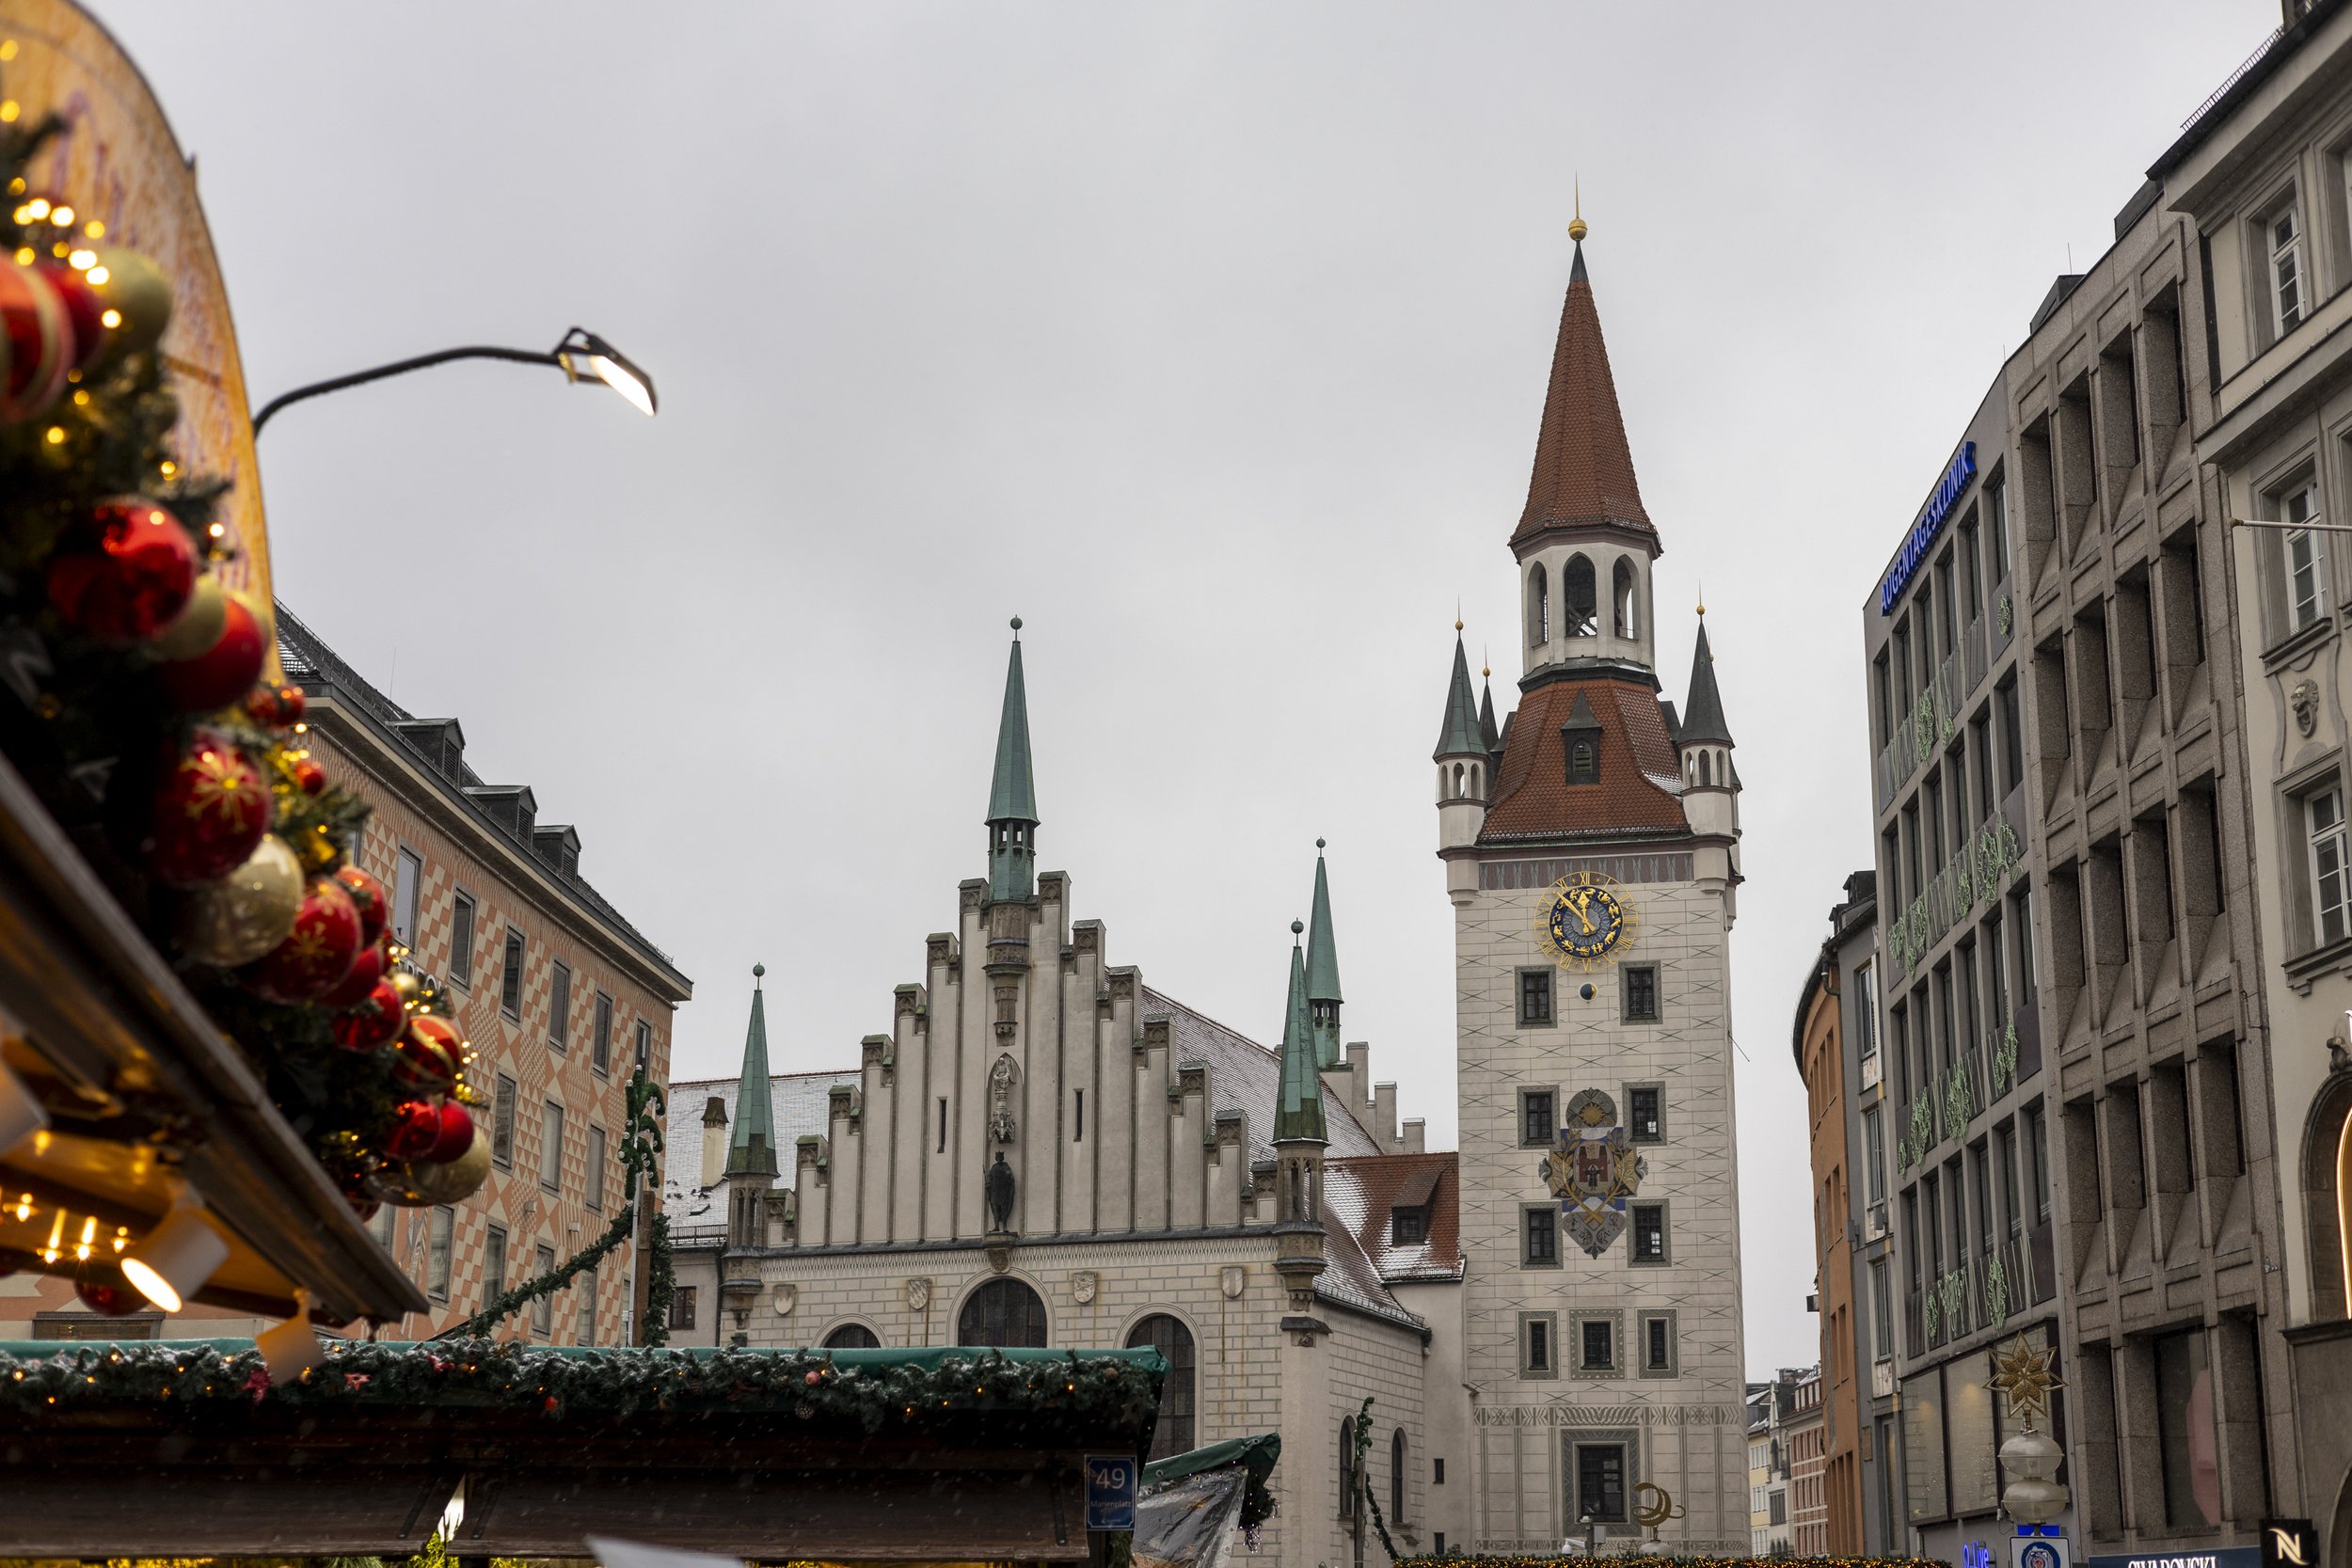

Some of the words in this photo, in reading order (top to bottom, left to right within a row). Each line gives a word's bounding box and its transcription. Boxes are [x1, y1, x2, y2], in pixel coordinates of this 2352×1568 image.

[1881, 444, 1971, 612] AUGENTAGESKLINIK
[1579, 871, 1591, 886] XII
[1096, 1467, 1126, 1489] 49
[1090, 1499, 1131, 1510] Marienplatz
[2267, 1528, 2311, 1566] N
